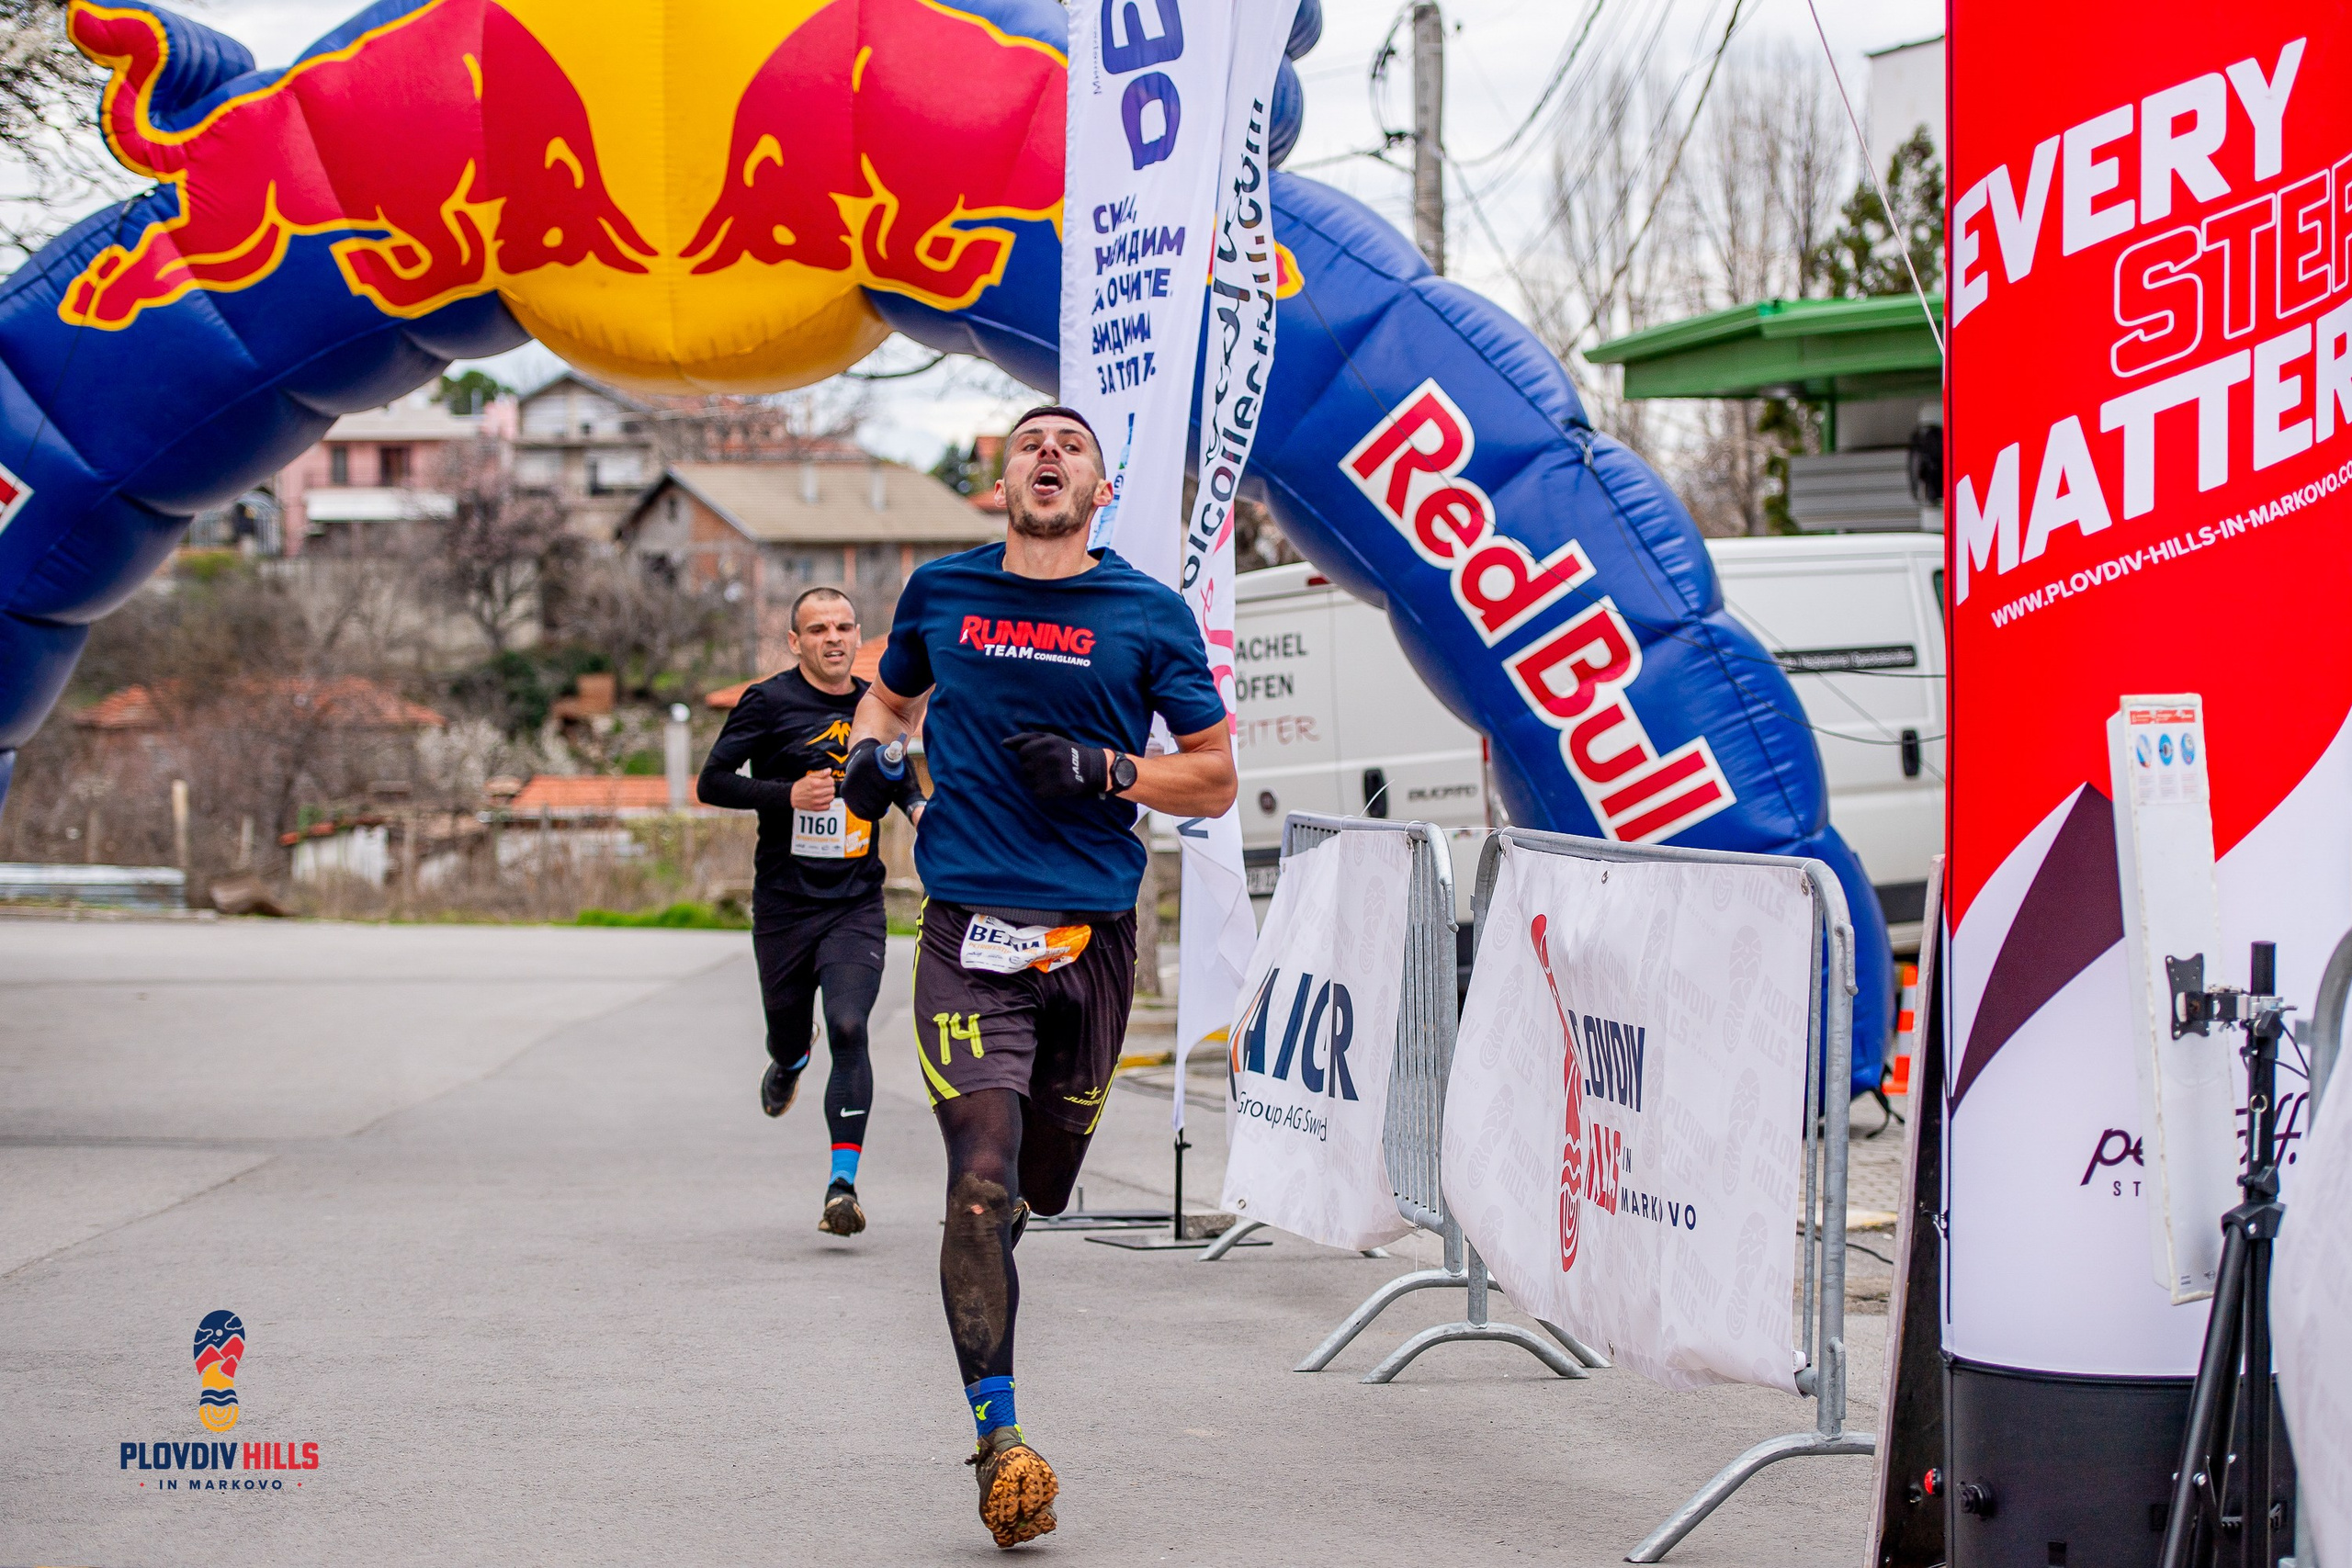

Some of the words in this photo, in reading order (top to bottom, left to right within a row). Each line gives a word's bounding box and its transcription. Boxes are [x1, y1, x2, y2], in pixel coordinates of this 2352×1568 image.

[1952, 36, 2307, 329] EVERY
[959, 615, 1096, 655] RUNNING
[1351, 390, 1583, 635] Red
[1514, 608, 1724, 842] Bull
[984, 644, 1034, 659] TEAM
[1034, 652, 1091, 667] CONEGLIANO
[799, 815, 837, 835] 1160
[933, 1011, 985, 1066] 14
[1568, 1010, 1645, 1113] OVDIV
[1238, 1091, 1282, 1129] Group
[1283, 1105, 1303, 1130] AG
